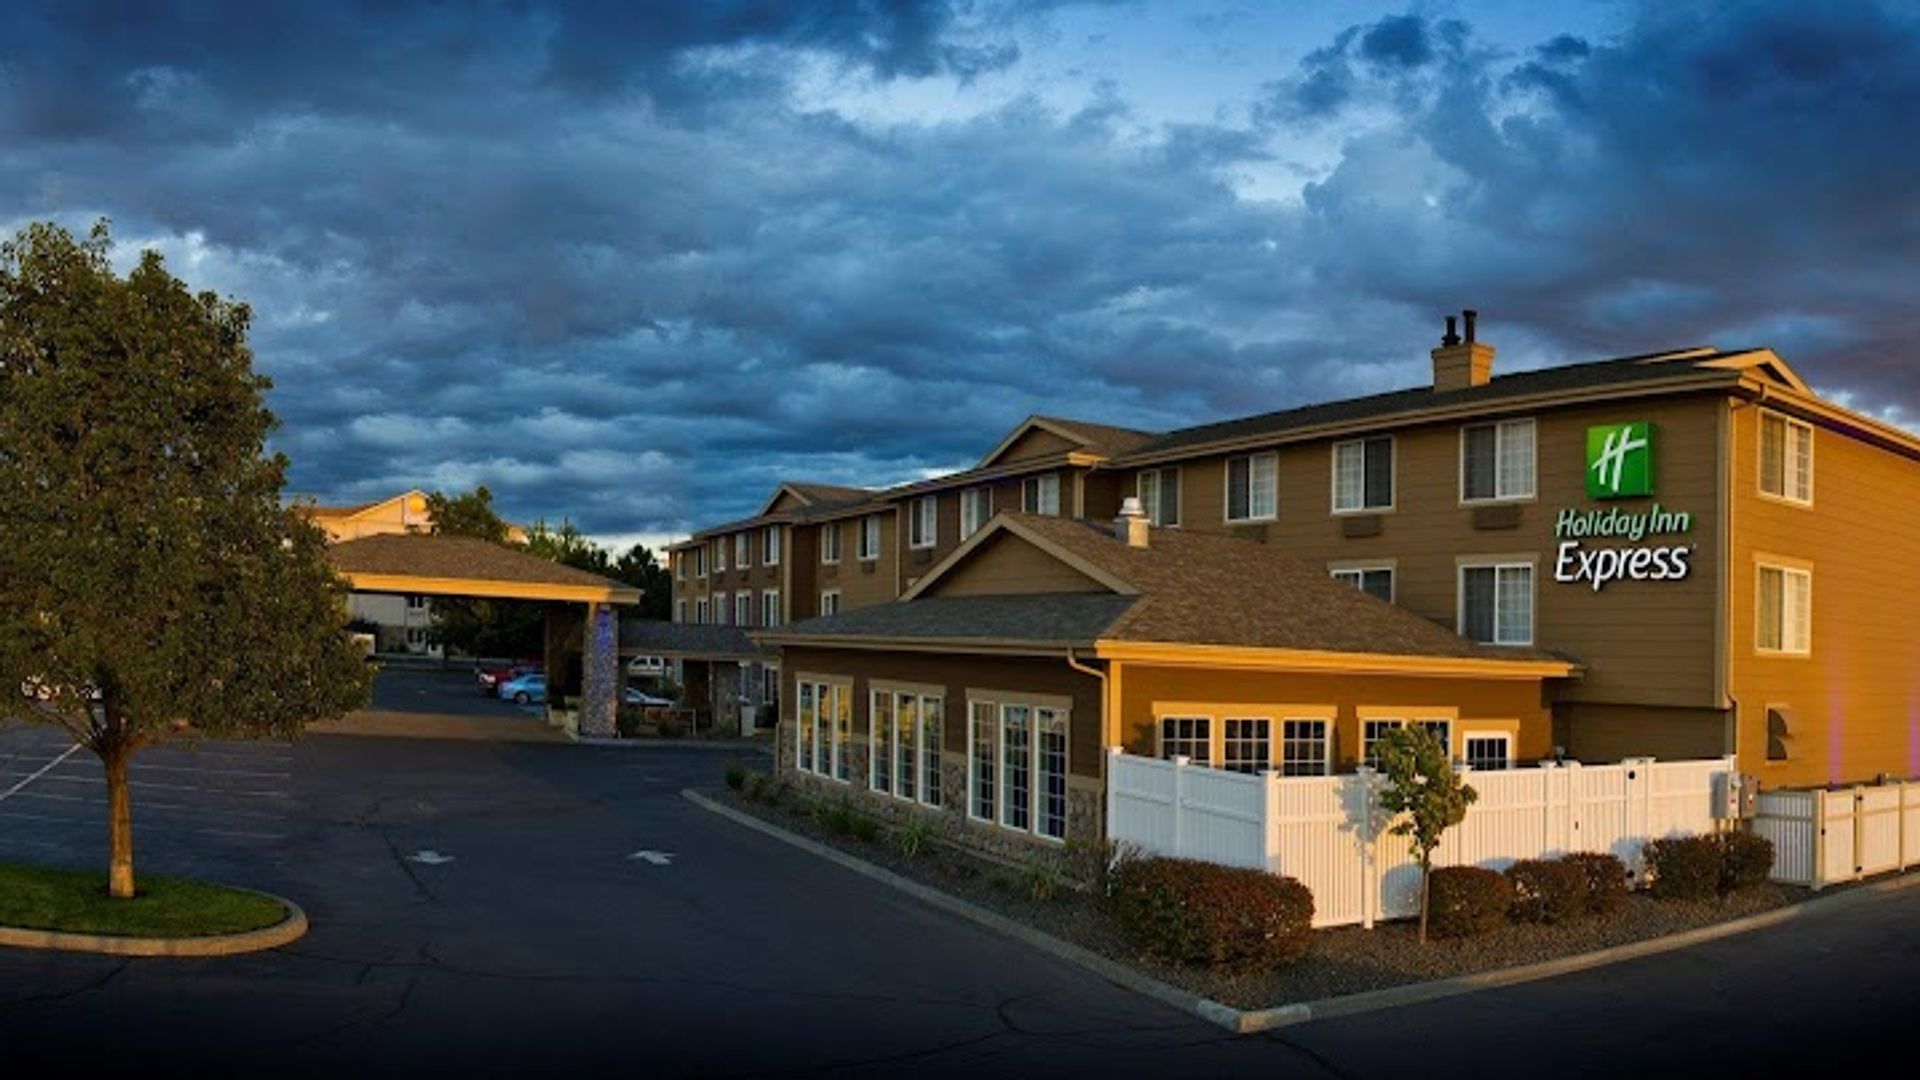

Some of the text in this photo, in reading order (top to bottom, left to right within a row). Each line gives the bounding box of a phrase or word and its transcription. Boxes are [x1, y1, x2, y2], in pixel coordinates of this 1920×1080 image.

[1555, 503, 1690, 541] Holiday Inn
[1555, 541, 1690, 592] Express
